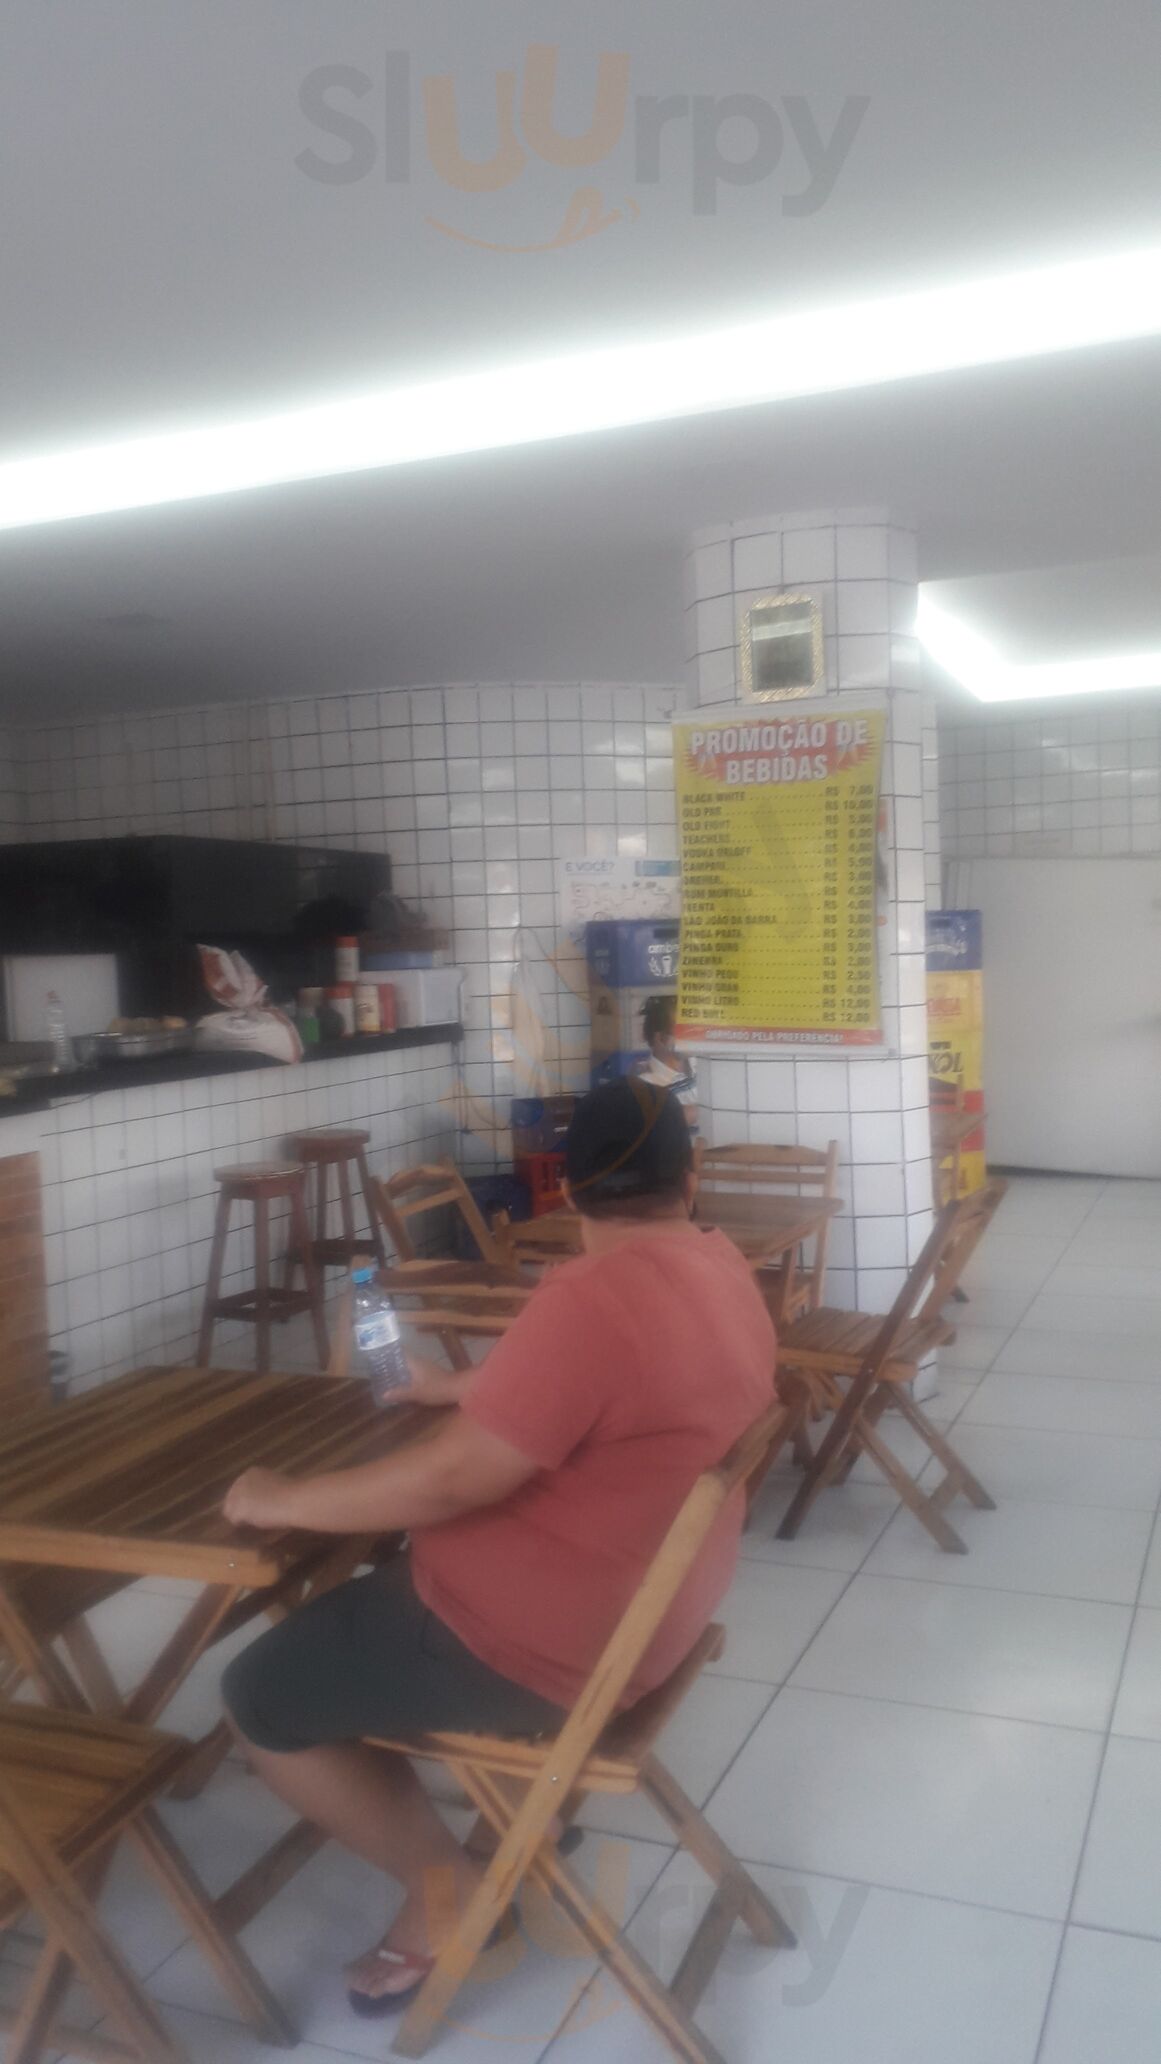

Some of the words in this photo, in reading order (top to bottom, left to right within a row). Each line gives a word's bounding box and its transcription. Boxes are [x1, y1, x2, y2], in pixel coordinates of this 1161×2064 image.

[690, 718, 828, 756] PROMOÇÃO
[835, 719, 870, 747] DE
[725, 754, 828, 785] BEBIDAS
[716, 791, 746, 802] WHITE
[682, 821, 701, 831] OLD
